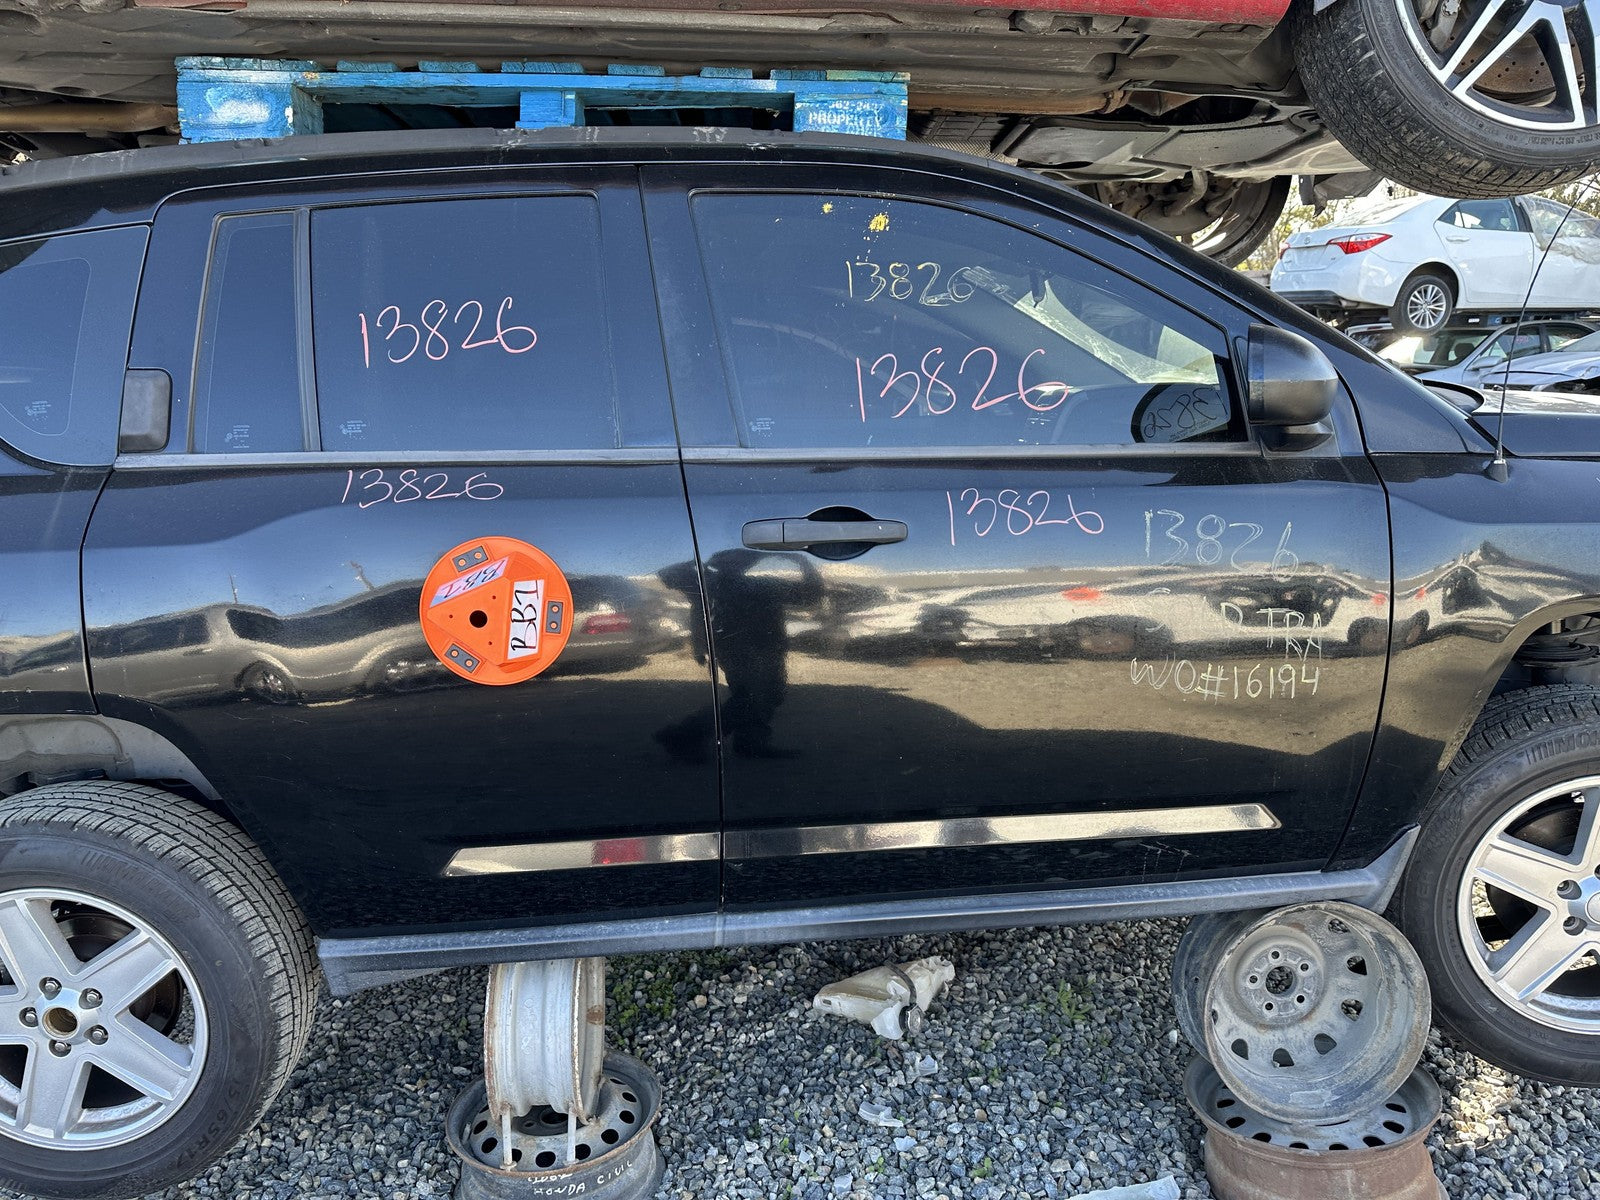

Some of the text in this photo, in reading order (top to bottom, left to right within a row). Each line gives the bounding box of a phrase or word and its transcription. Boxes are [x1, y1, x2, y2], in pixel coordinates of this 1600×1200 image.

[846, 260, 977, 306] 13826
[358, 297, 538, 368] 13826
[856, 346, 1070, 423] 13826
[341, 469, 504, 508] 13826
[946, 488, 1105, 546] 13826
[1145, 509, 1299, 582] 13826
[1256, 607, 1322, 662] TRA
[533, 1182, 586, 1196] HONDA
